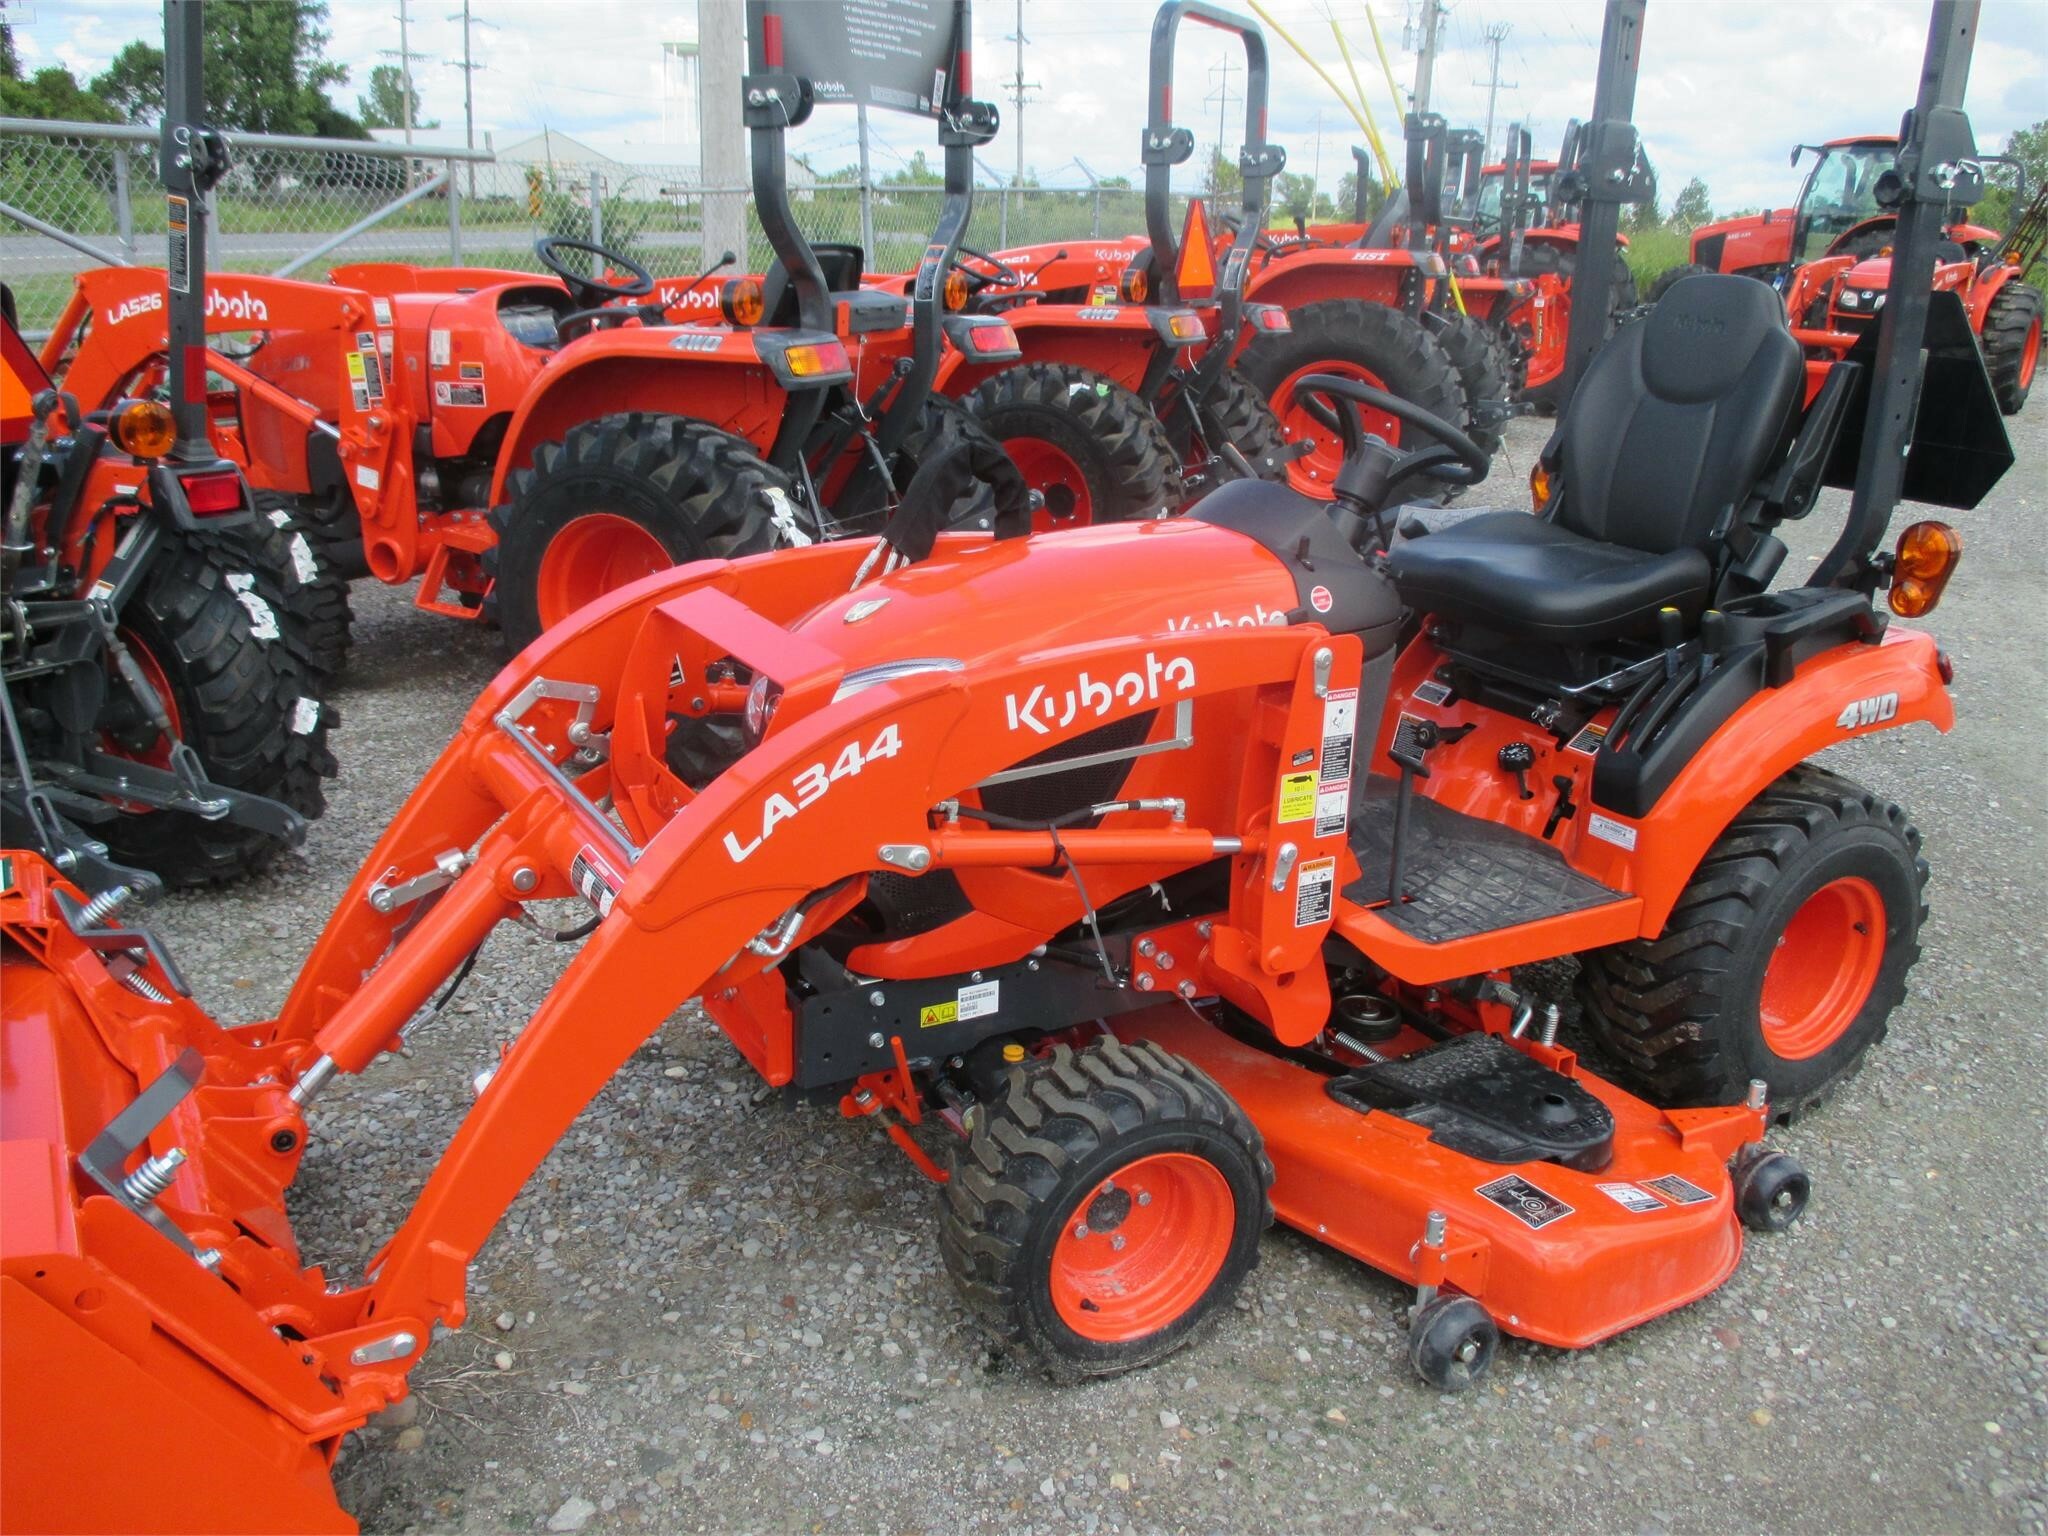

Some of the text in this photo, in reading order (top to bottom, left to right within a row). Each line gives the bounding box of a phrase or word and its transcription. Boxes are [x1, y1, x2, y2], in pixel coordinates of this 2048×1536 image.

[814, 80, 846, 93] Kubota
[1095, 249, 1137, 261] Kubot
[1352, 252, 1390, 261] HST
[107, 292, 163, 326] LA526
[205, 288, 269, 321] ubota
[1076, 308, 1120, 321] 4WD
[669, 333, 724, 353] 4WD
[1005, 652, 1195, 734] Kubota
[1332, 691, 1356, 700] DANGER
[1836, 692, 1898, 731] 4WD
[722, 723, 903, 864] LA344
[1324, 783, 1348, 792] DANGER
[1284, 794, 1312, 804] LUBRICATE
